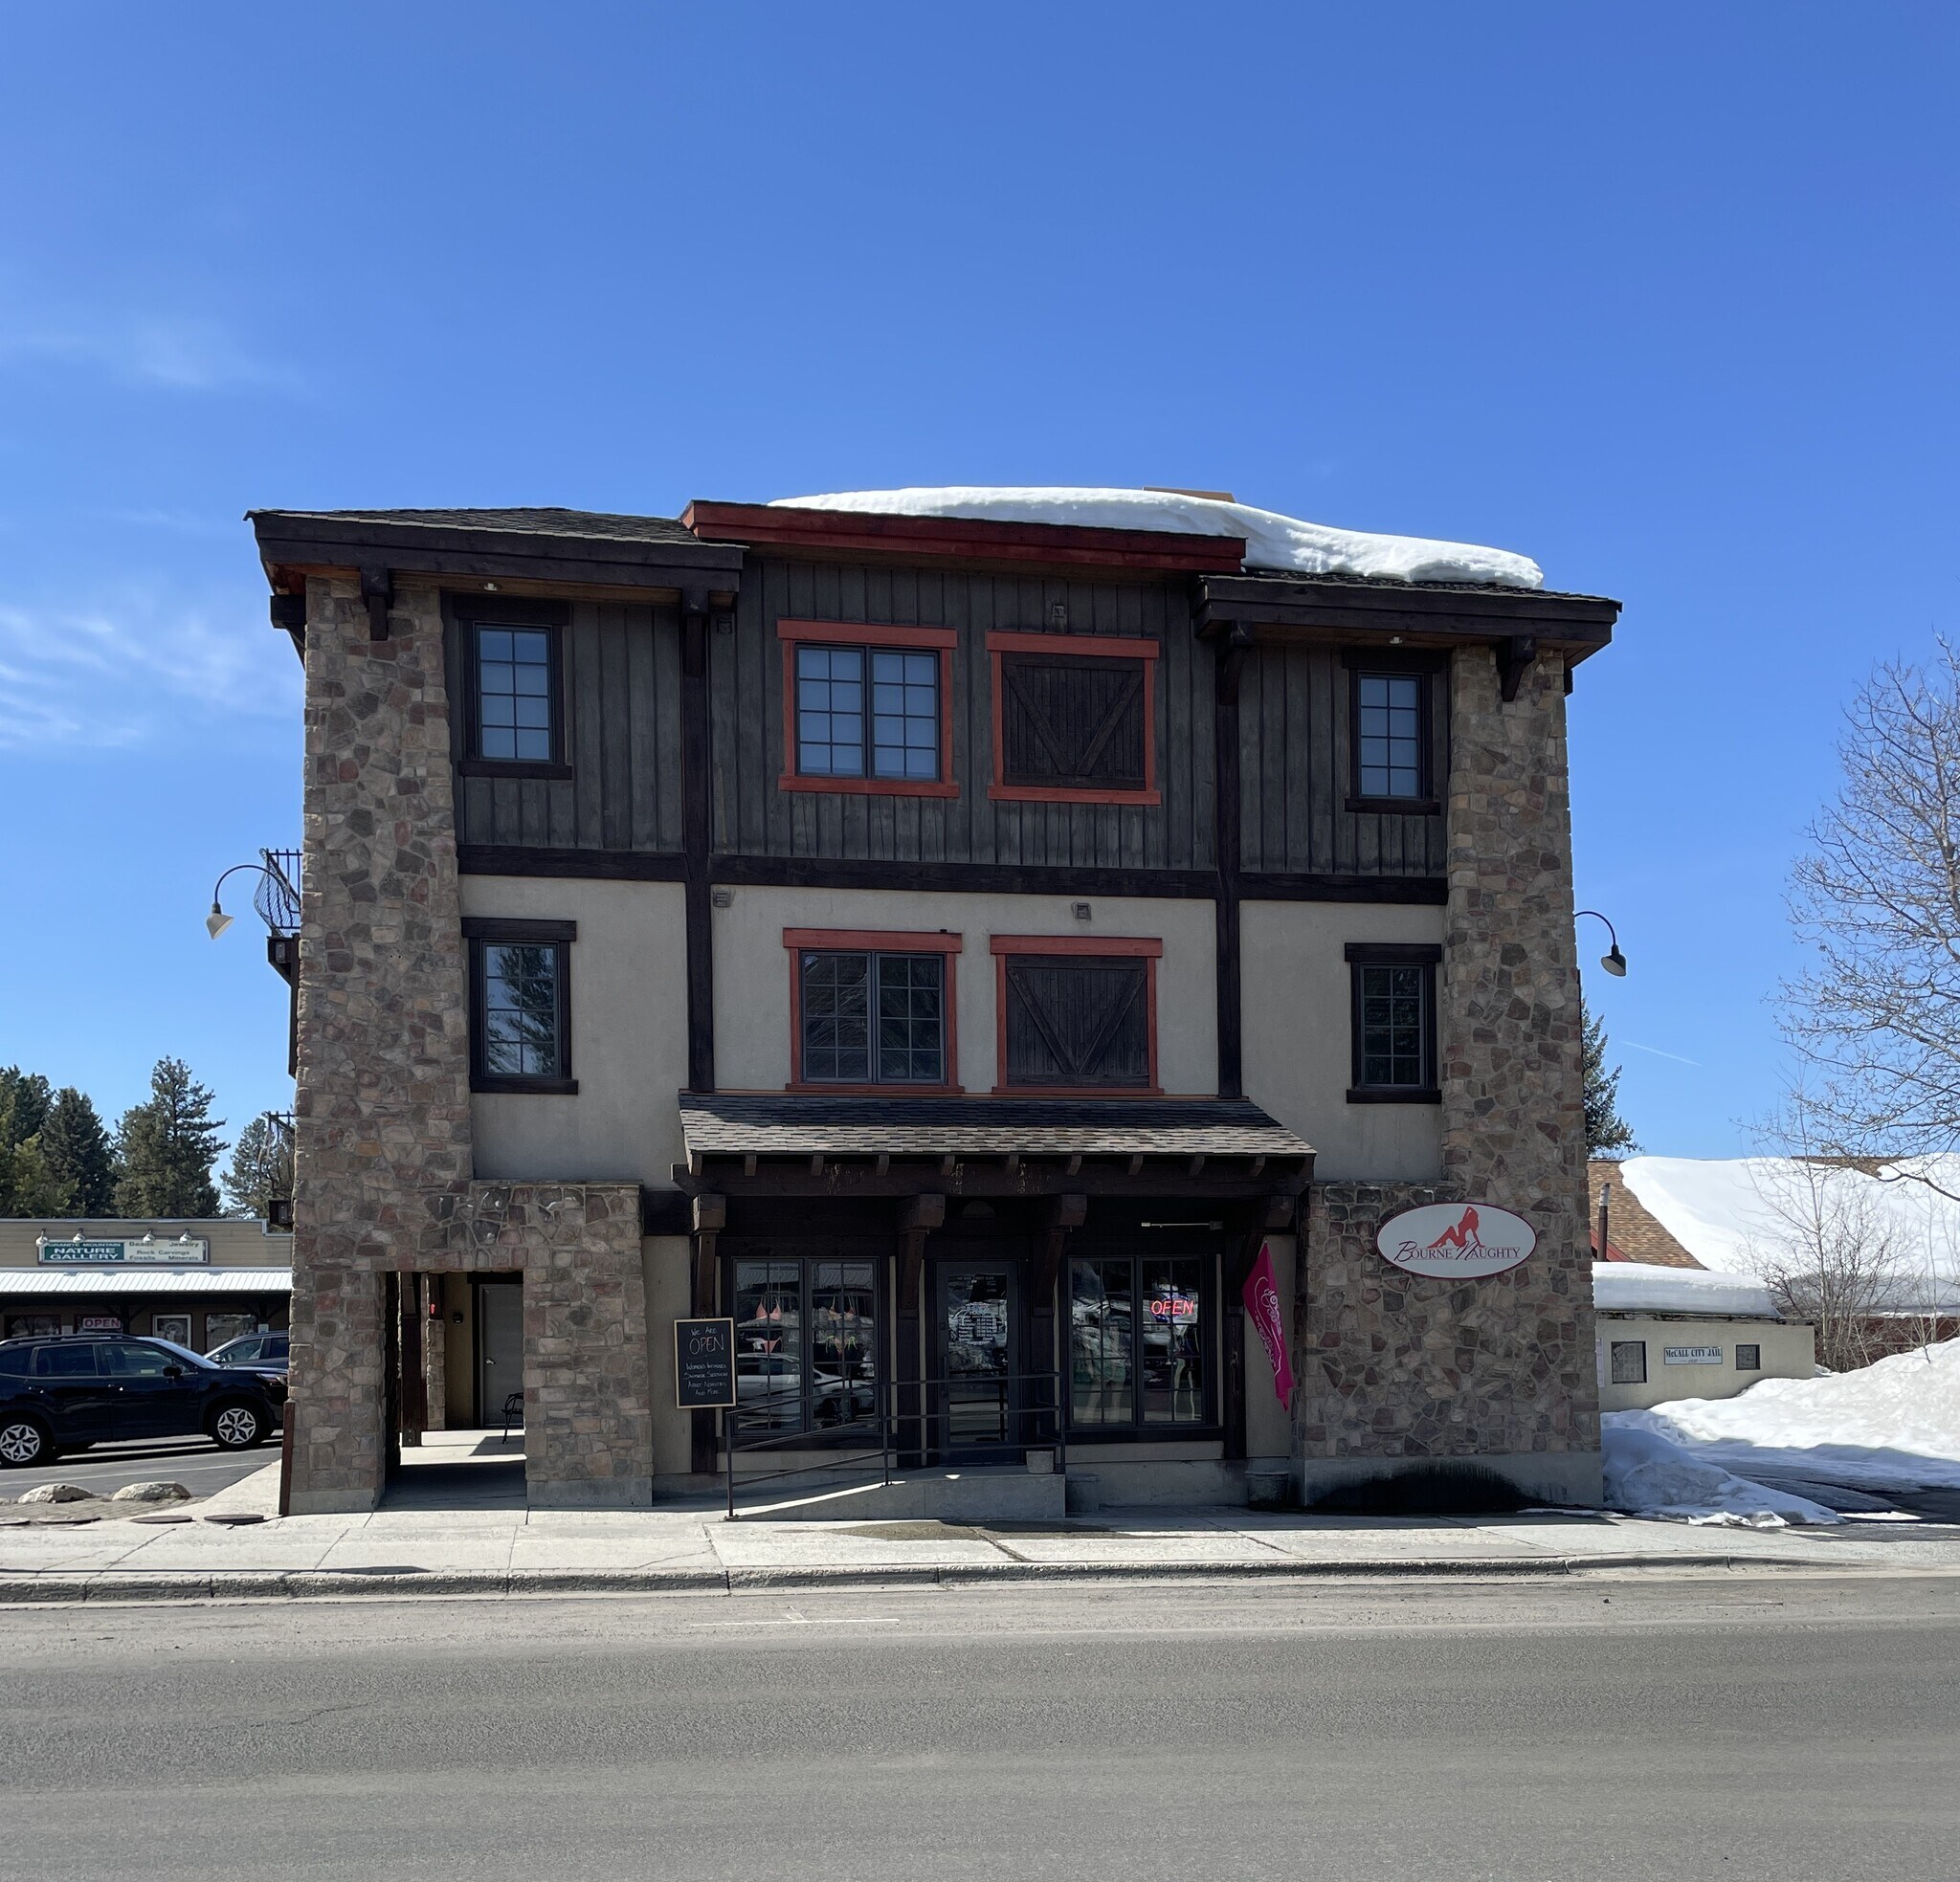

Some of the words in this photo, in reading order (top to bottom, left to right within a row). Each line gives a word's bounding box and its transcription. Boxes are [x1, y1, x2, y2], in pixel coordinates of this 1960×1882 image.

[1393, 1240, 1454, 1263] BOURNE
[1455, 1240, 1521, 1262] NAUGHTY
[1150, 1298, 1194, 1316] OPEN
[84, 1318, 120, 1328] OPEN
[689, 1333, 724, 1355] OPEN
[1665, 1348, 1689, 1358] McCALL
[1690, 1348, 1705, 1358] CITY
[1706, 1348, 1722, 1357] JAIL
